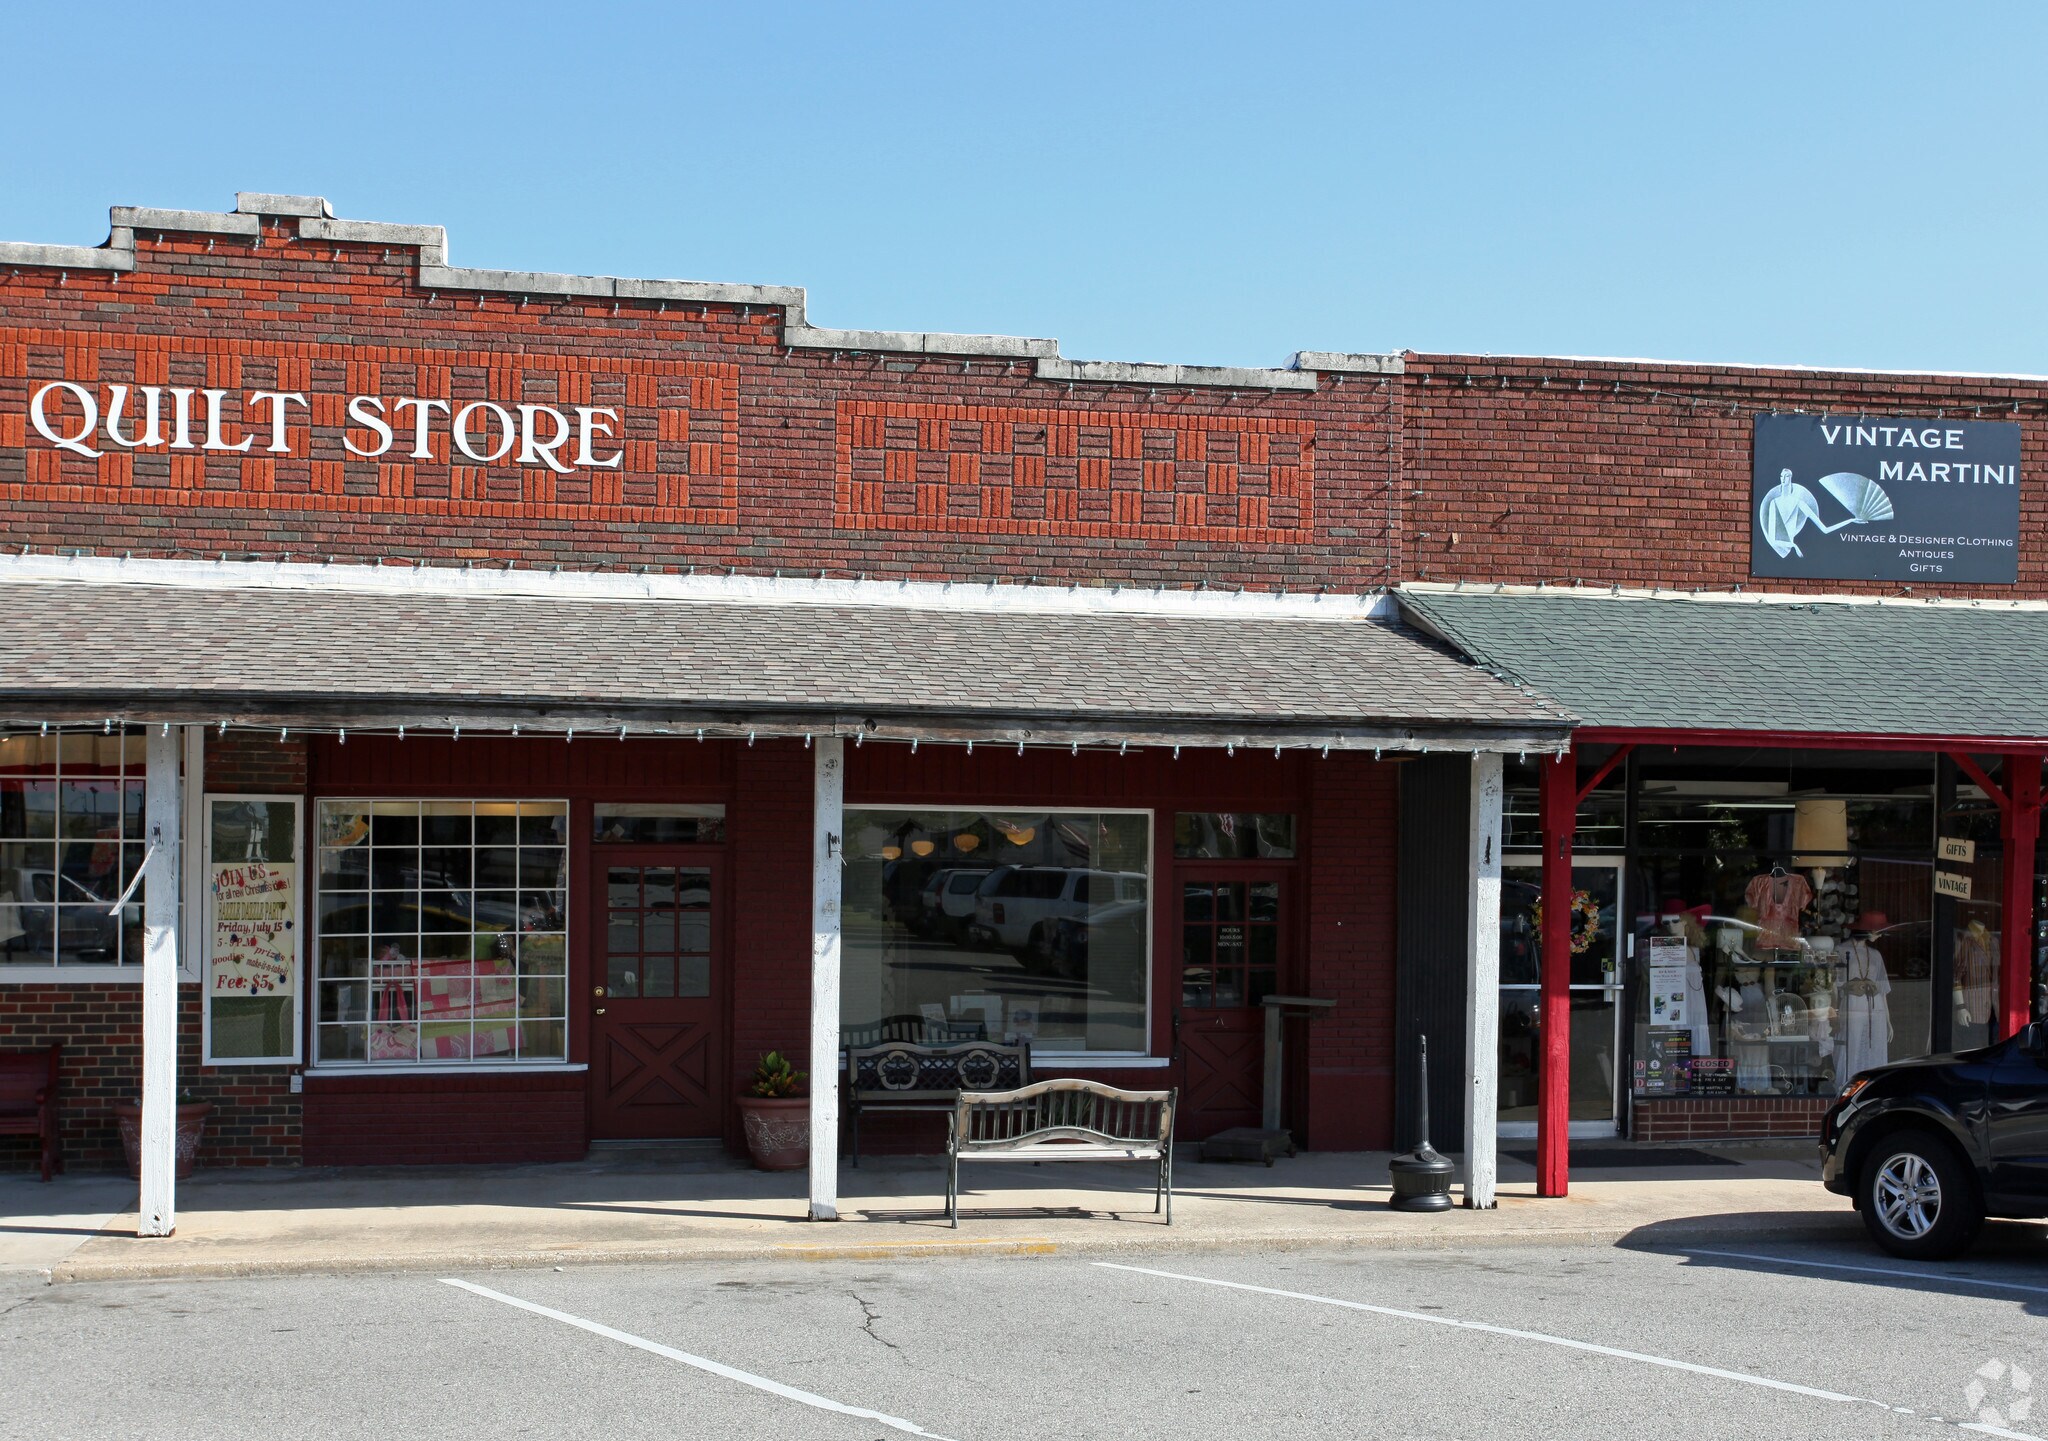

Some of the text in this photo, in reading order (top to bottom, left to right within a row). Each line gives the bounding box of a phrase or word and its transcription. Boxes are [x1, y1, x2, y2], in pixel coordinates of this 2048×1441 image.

[30, 381, 624, 474] QUILT STORE
[1820, 424, 1964, 450] VINTAGE
[1879, 460, 2015, 485] MARTINI
[1839, 533, 2014, 547] VINTAGE & DESIGNER CLOTHING
[1898, 548, 1954, 559] ANTIQUES
[1909, 563, 1943, 573] GIFTS
[1946, 843, 1967, 857] GIFTS
[248, 863, 266, 881] US
[1938, 877, 1968, 894] VINTAGE
[233, 889, 244, 898] new
[217, 922, 283, 934] Friday, July 15
[217, 938, 223, 948] 5
[1694, 1060, 1730, 1068] CLOSED
